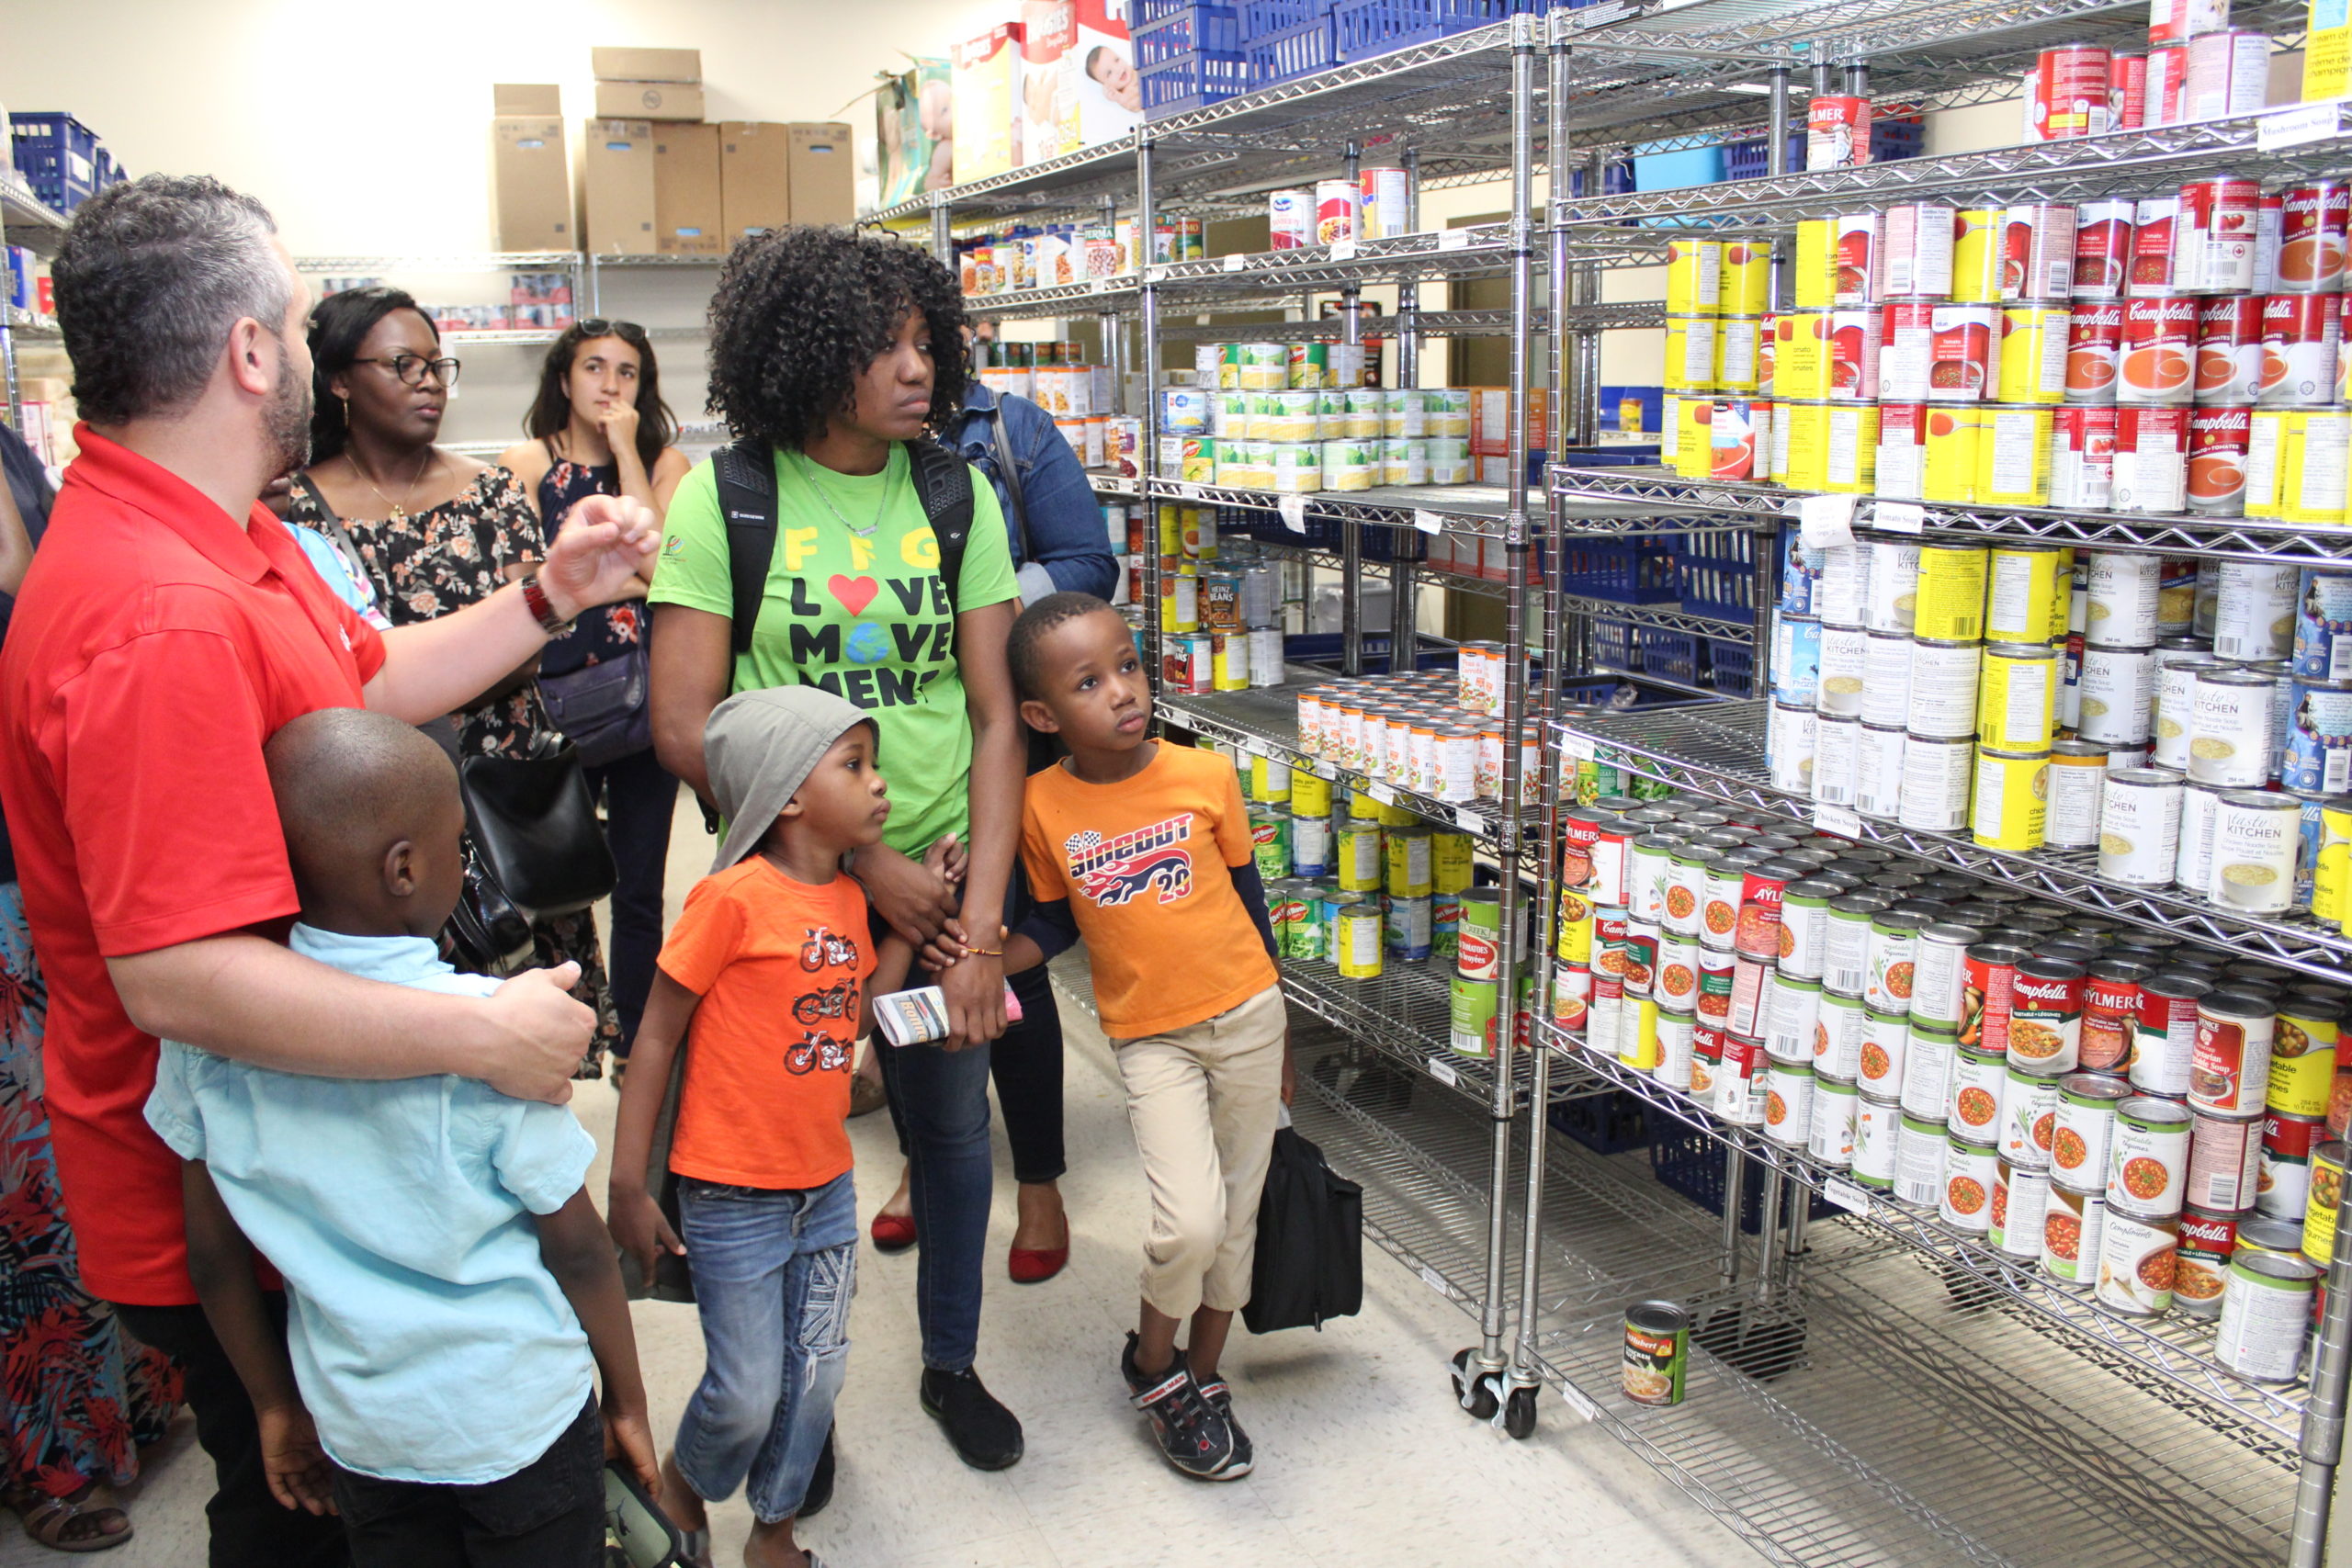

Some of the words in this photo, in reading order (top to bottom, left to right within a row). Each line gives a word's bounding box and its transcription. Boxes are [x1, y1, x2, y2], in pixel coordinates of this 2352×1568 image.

[2282, 192, 2347, 214] Campbell's
[2129, 300, 2194, 321] Campbell's
[2133, 337, 2157, 348] TOMATO
[2161, 334, 2188, 344] TOMATES
[2089, 569, 2112, 580] CHEN
[1209, 592, 1234, 602] BEANS
[1211, 585, 1230, 594] HEINZ
[2086, 666, 2110, 676] CHEN
[2162, 683, 2186, 695] CHEN
[2194, 699, 2239, 715] KITCHEN
[2106, 798, 2137, 812] TCHEN
[1566, 825, 1597, 841] YLMER
[2227, 824, 2282, 839] KITCHEN
[1753, 887, 1782, 903] AYL
[1464, 942, 1489, 955] TOMATOES
[2013, 976, 2068, 1000] Campbell's
[2270, 1059, 2297, 1074] etable
[2109, 1221, 2153, 1240] Compliments
[2179, 1221, 2228, 1242] mpbell's
